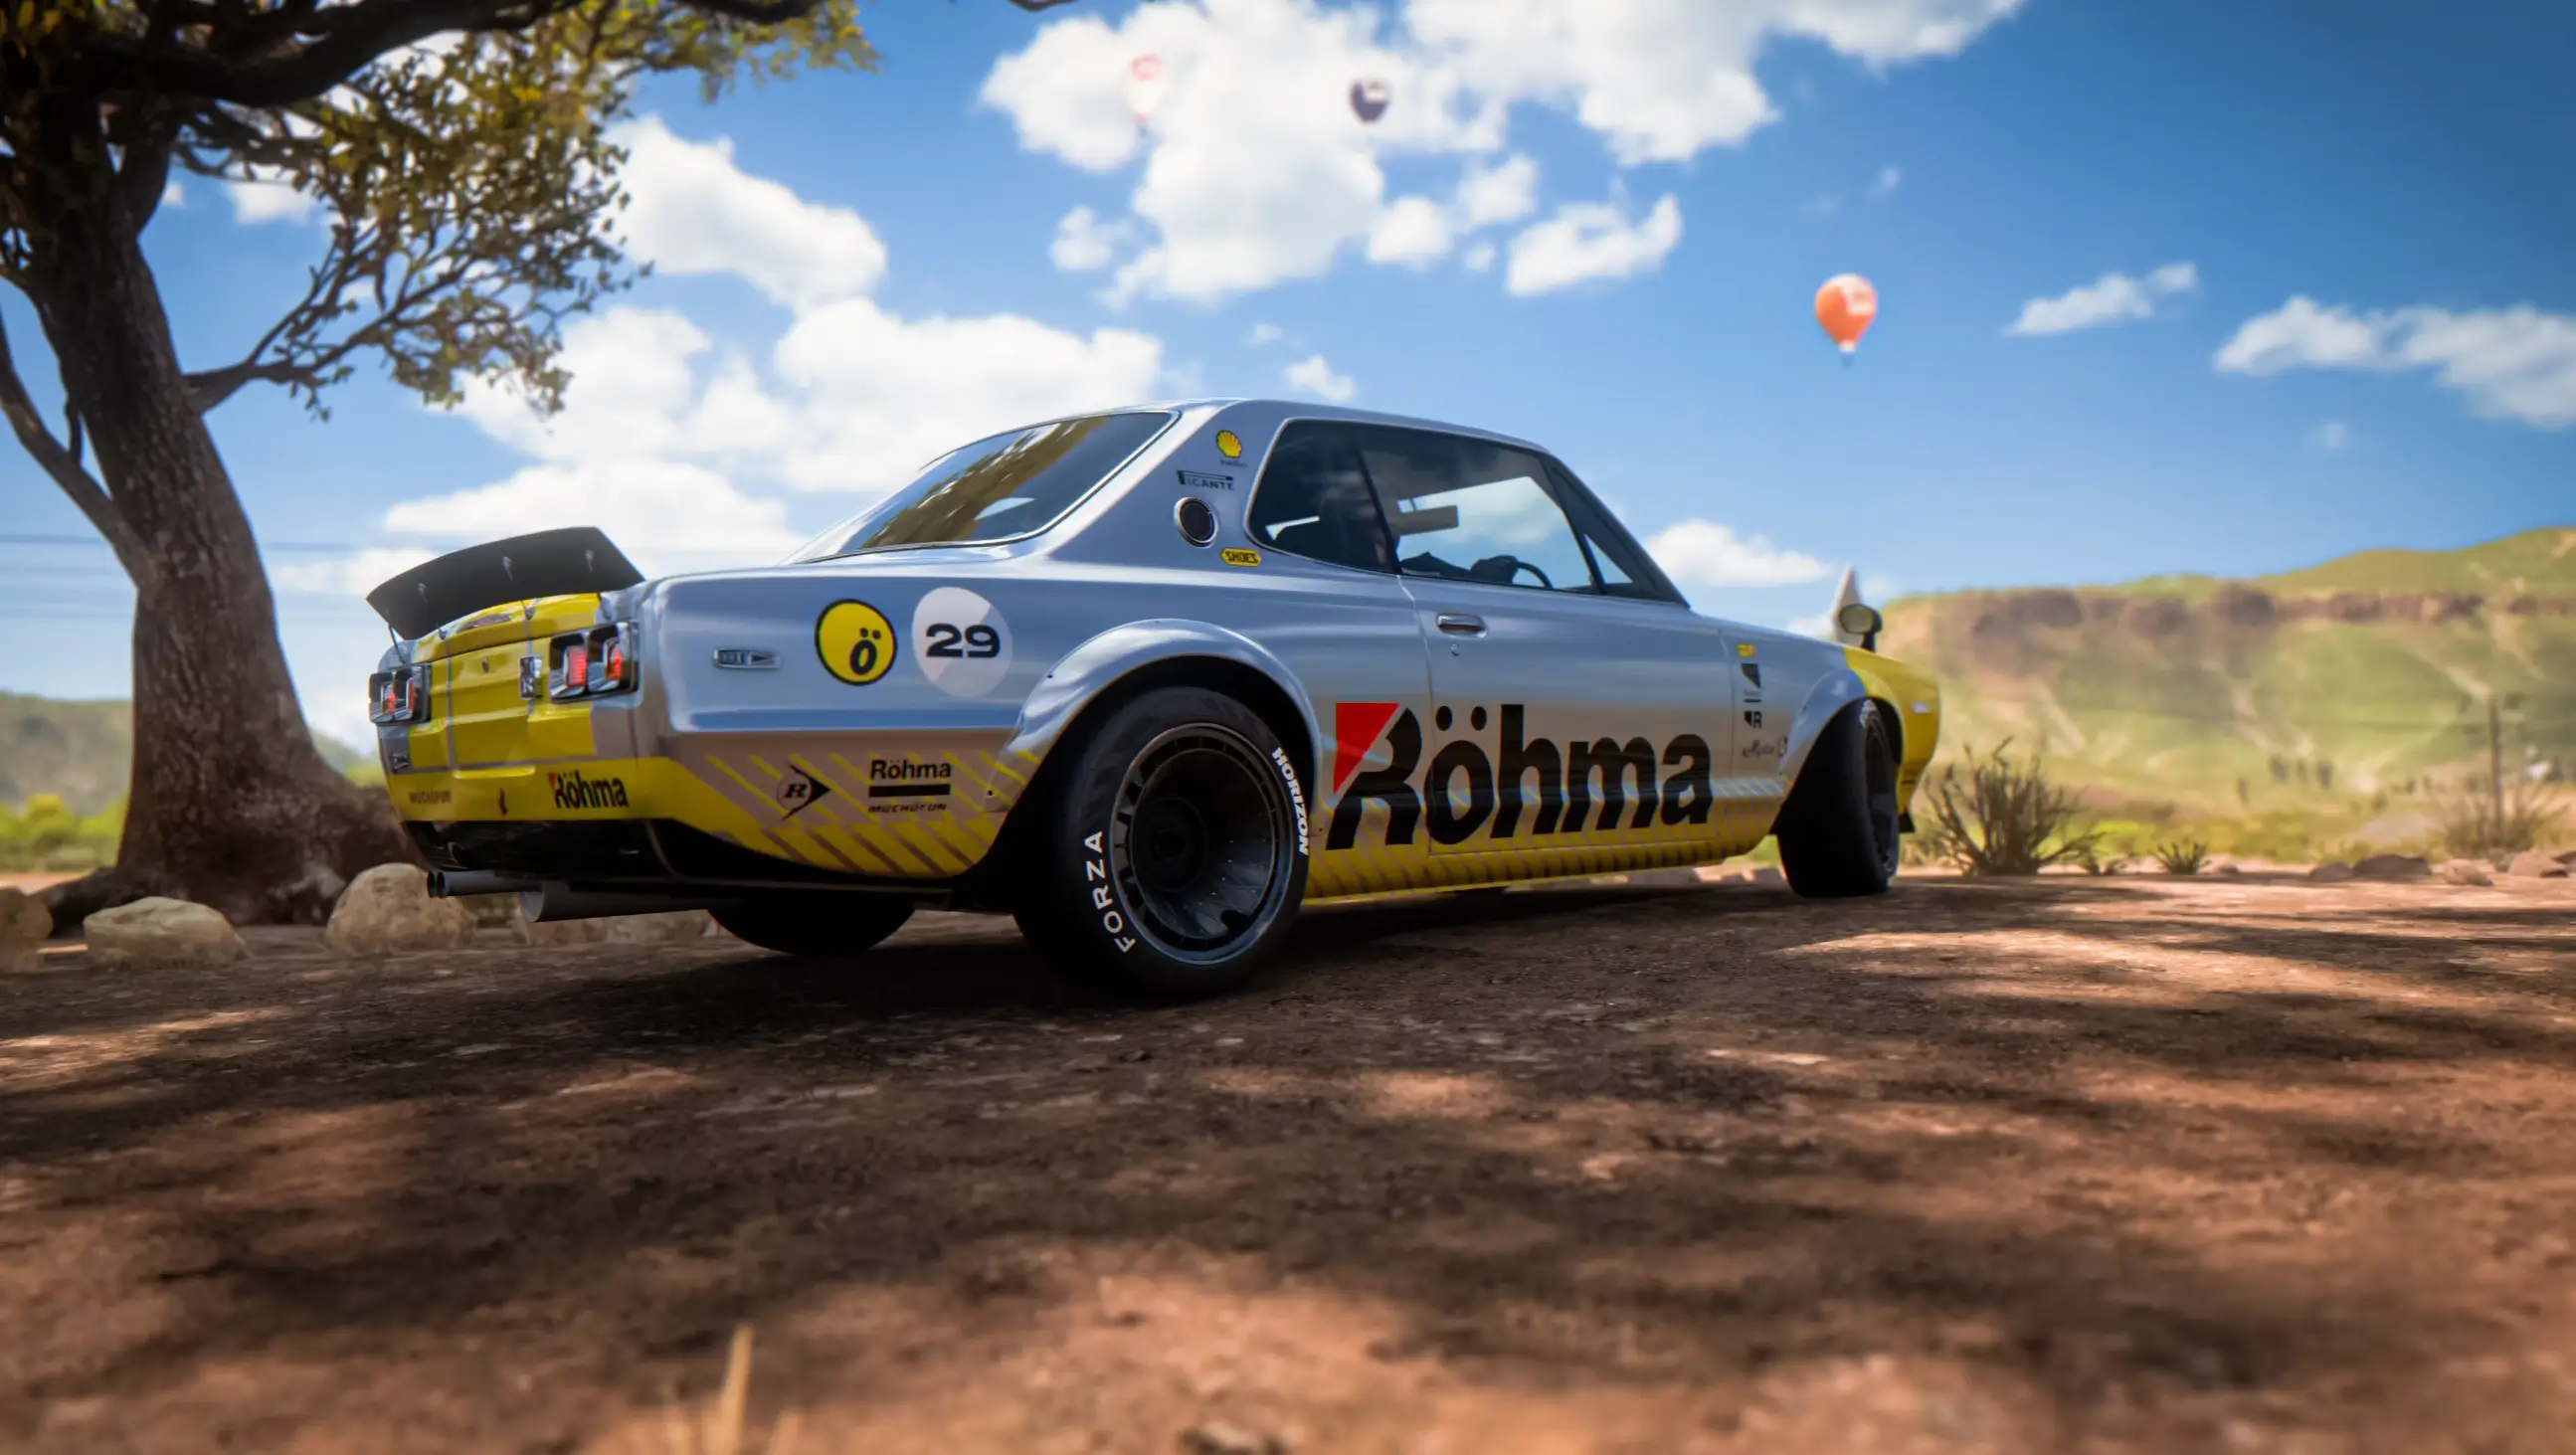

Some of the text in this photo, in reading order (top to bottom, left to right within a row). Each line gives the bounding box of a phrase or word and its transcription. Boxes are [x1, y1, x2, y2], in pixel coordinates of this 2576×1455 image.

[925, 623, 1001, 659] 29
[548, 769, 630, 810] Röhma
[870, 759, 952, 780] Röhma
[1326, 702, 1713, 849] Röhma
[783, 783, 808, 799] R
[1270, 746, 1310, 856] HORIZON
[1083, 830, 1137, 953] FORZA
